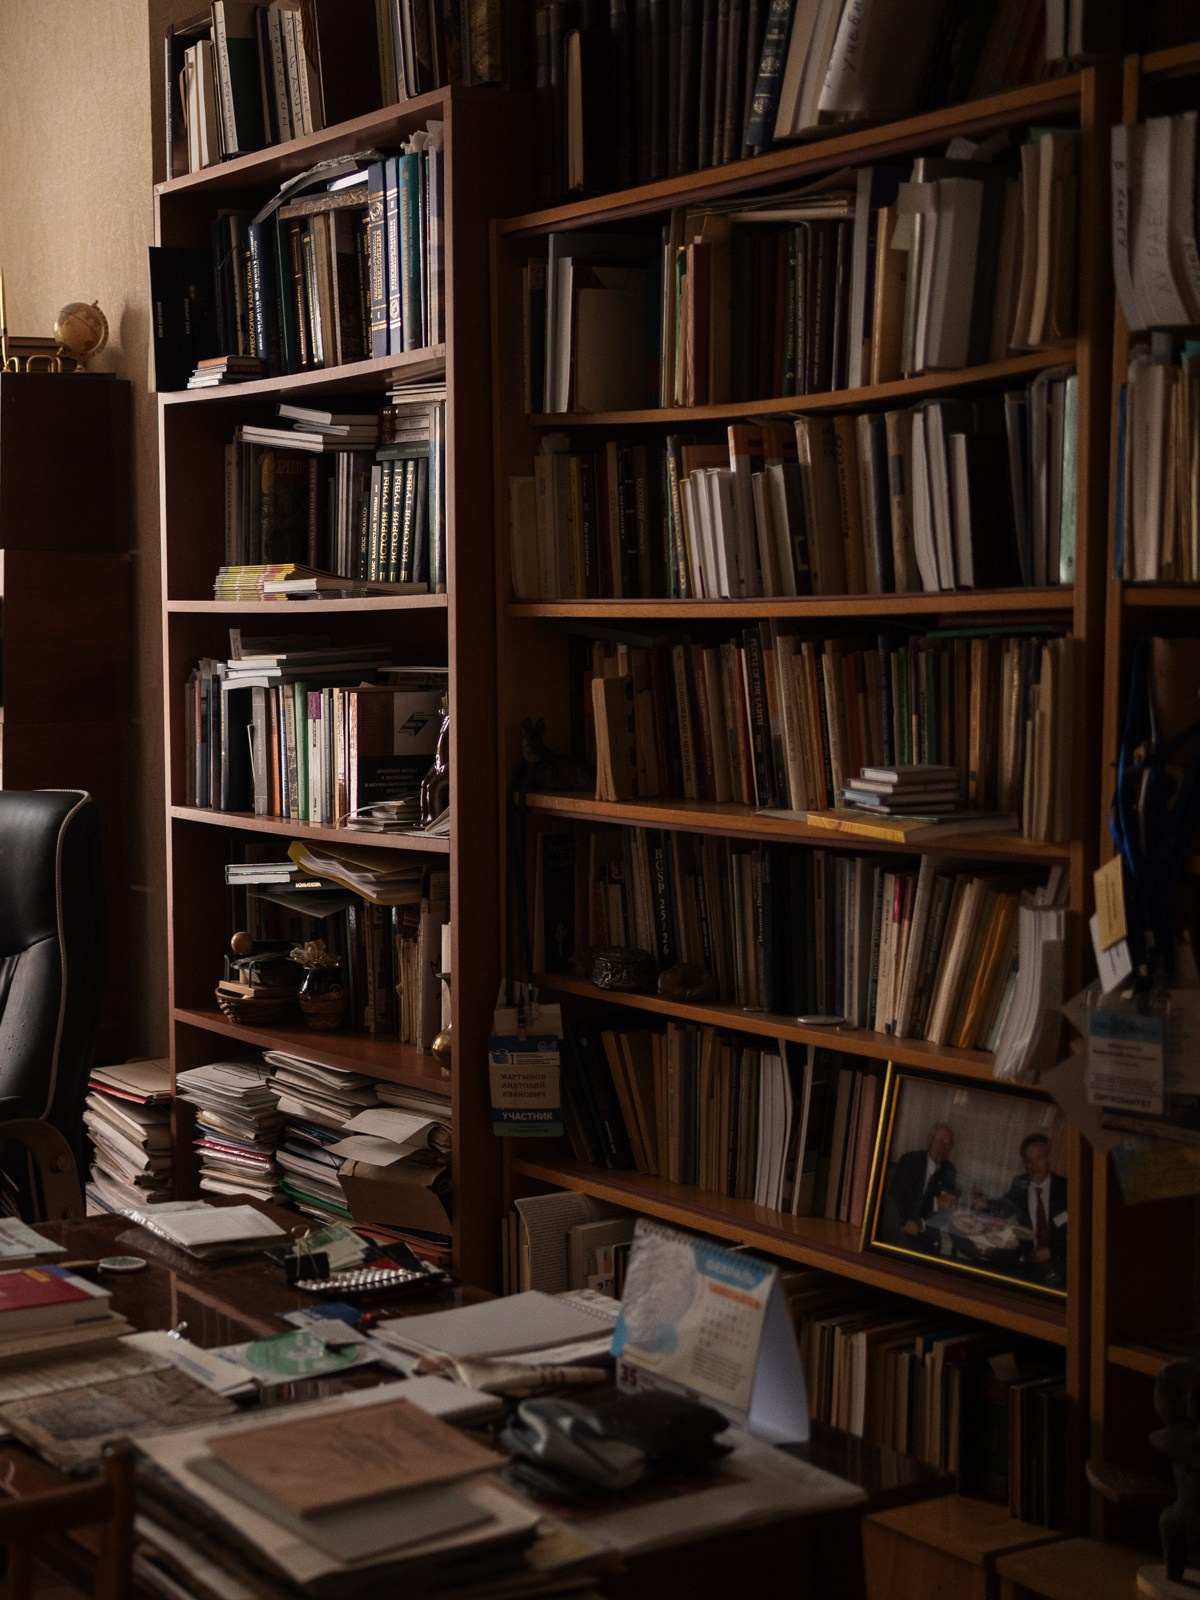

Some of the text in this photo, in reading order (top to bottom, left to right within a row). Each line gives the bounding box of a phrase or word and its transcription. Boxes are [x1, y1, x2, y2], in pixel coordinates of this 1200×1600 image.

[380, 476, 390, 563] ИСТОРИЯ ТУВЫ
[391, 475, 401, 563] ИСТОРИЯ ТУВЫ
[401, 474, 413, 562] ИСТОРИЯ ТУВЫ
[836, 433, 850, 538] Археология СССР
[502, 1081, 545, 1089] АНАТОЛИЙ
[502, 1112, 553, 1120] УЧАСТНИК
[620, 1363, 637, 1387] 35
